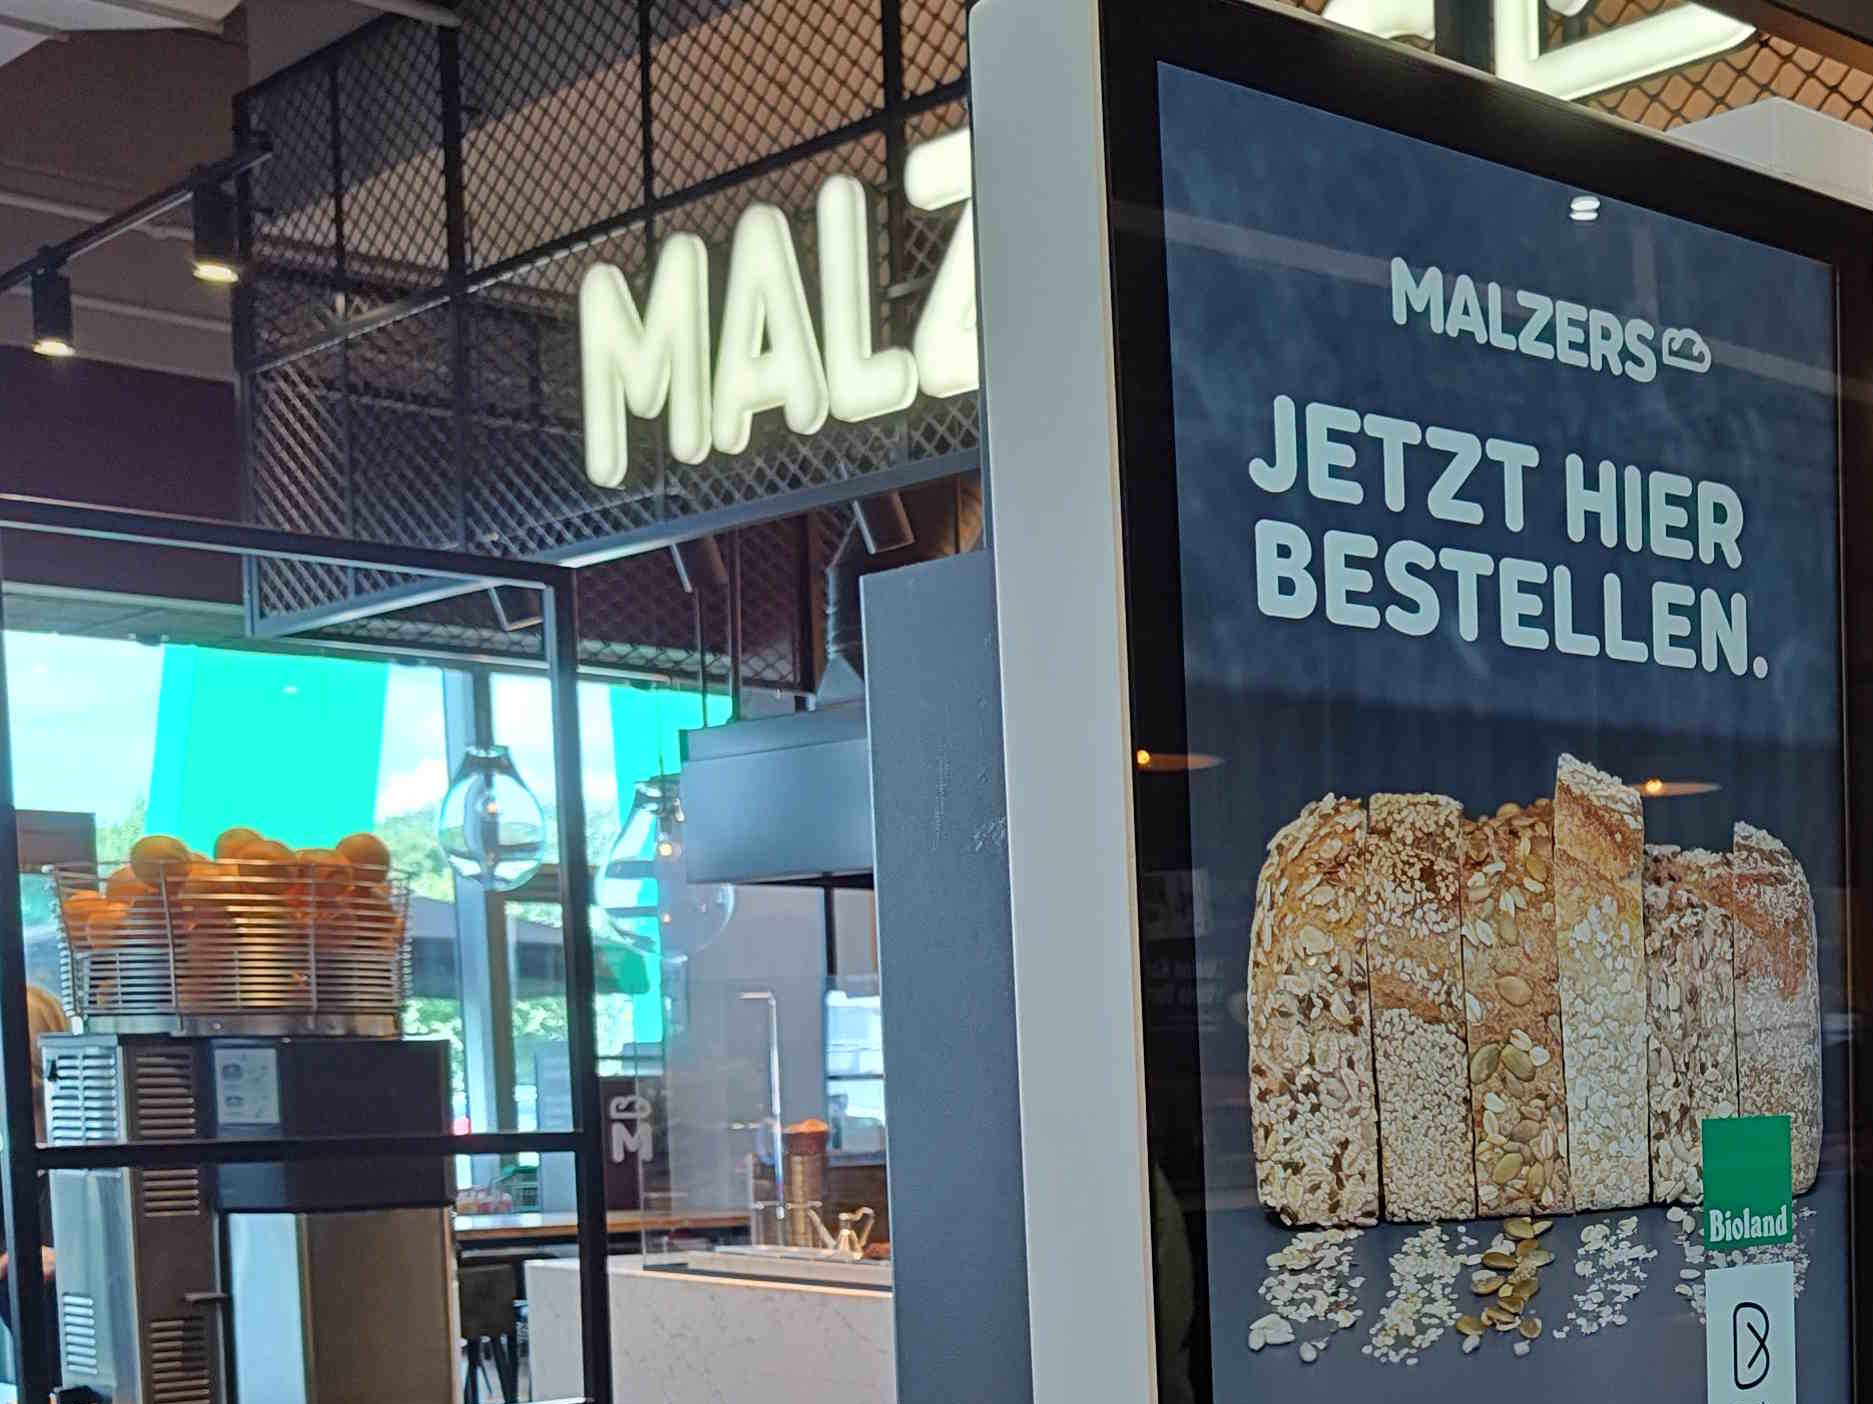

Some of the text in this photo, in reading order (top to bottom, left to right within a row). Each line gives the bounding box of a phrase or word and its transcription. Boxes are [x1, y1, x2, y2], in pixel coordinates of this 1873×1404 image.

[1391, 256, 1657, 383] MALZERS
[1248, 394, 1540, 533] JETZT
[1565, 453, 1744, 569] HIER
[1254, 518, 1769, 680] BESTELLEN.
[1709, 1204, 1788, 1243] Bioland
